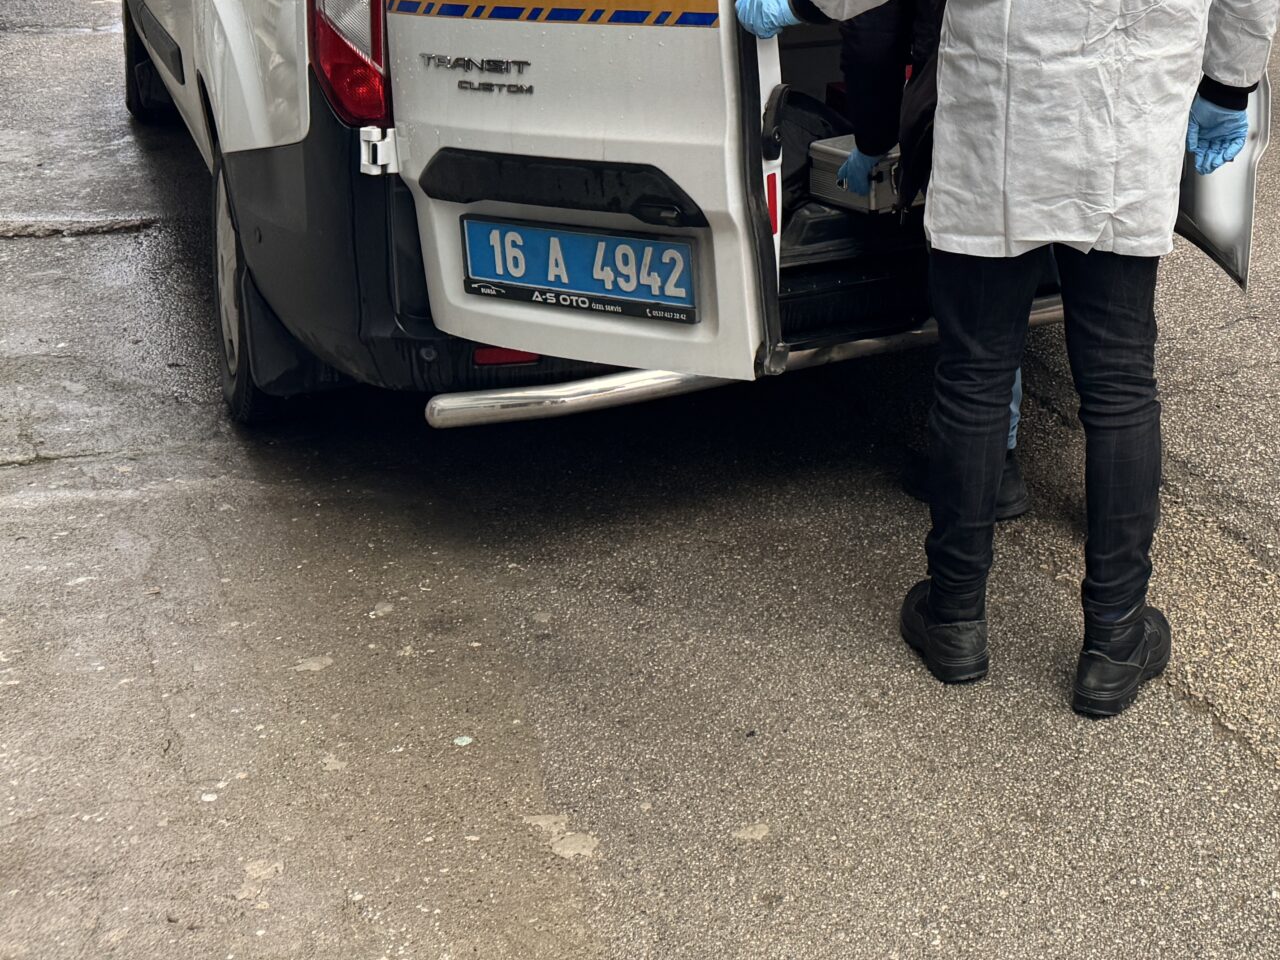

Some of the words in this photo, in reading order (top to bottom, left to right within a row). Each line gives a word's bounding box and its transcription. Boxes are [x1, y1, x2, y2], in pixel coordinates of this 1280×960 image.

[419, 53, 531, 74] TRANSIT
[458, 80, 533, 94] CUSTOM
[489, 229, 526, 278] 16
[547, 237, 569, 284] A
[592, 241, 687, 298] 4942
[532, 290, 556, 304] A-S
[559, 294, 590, 309] OTO
